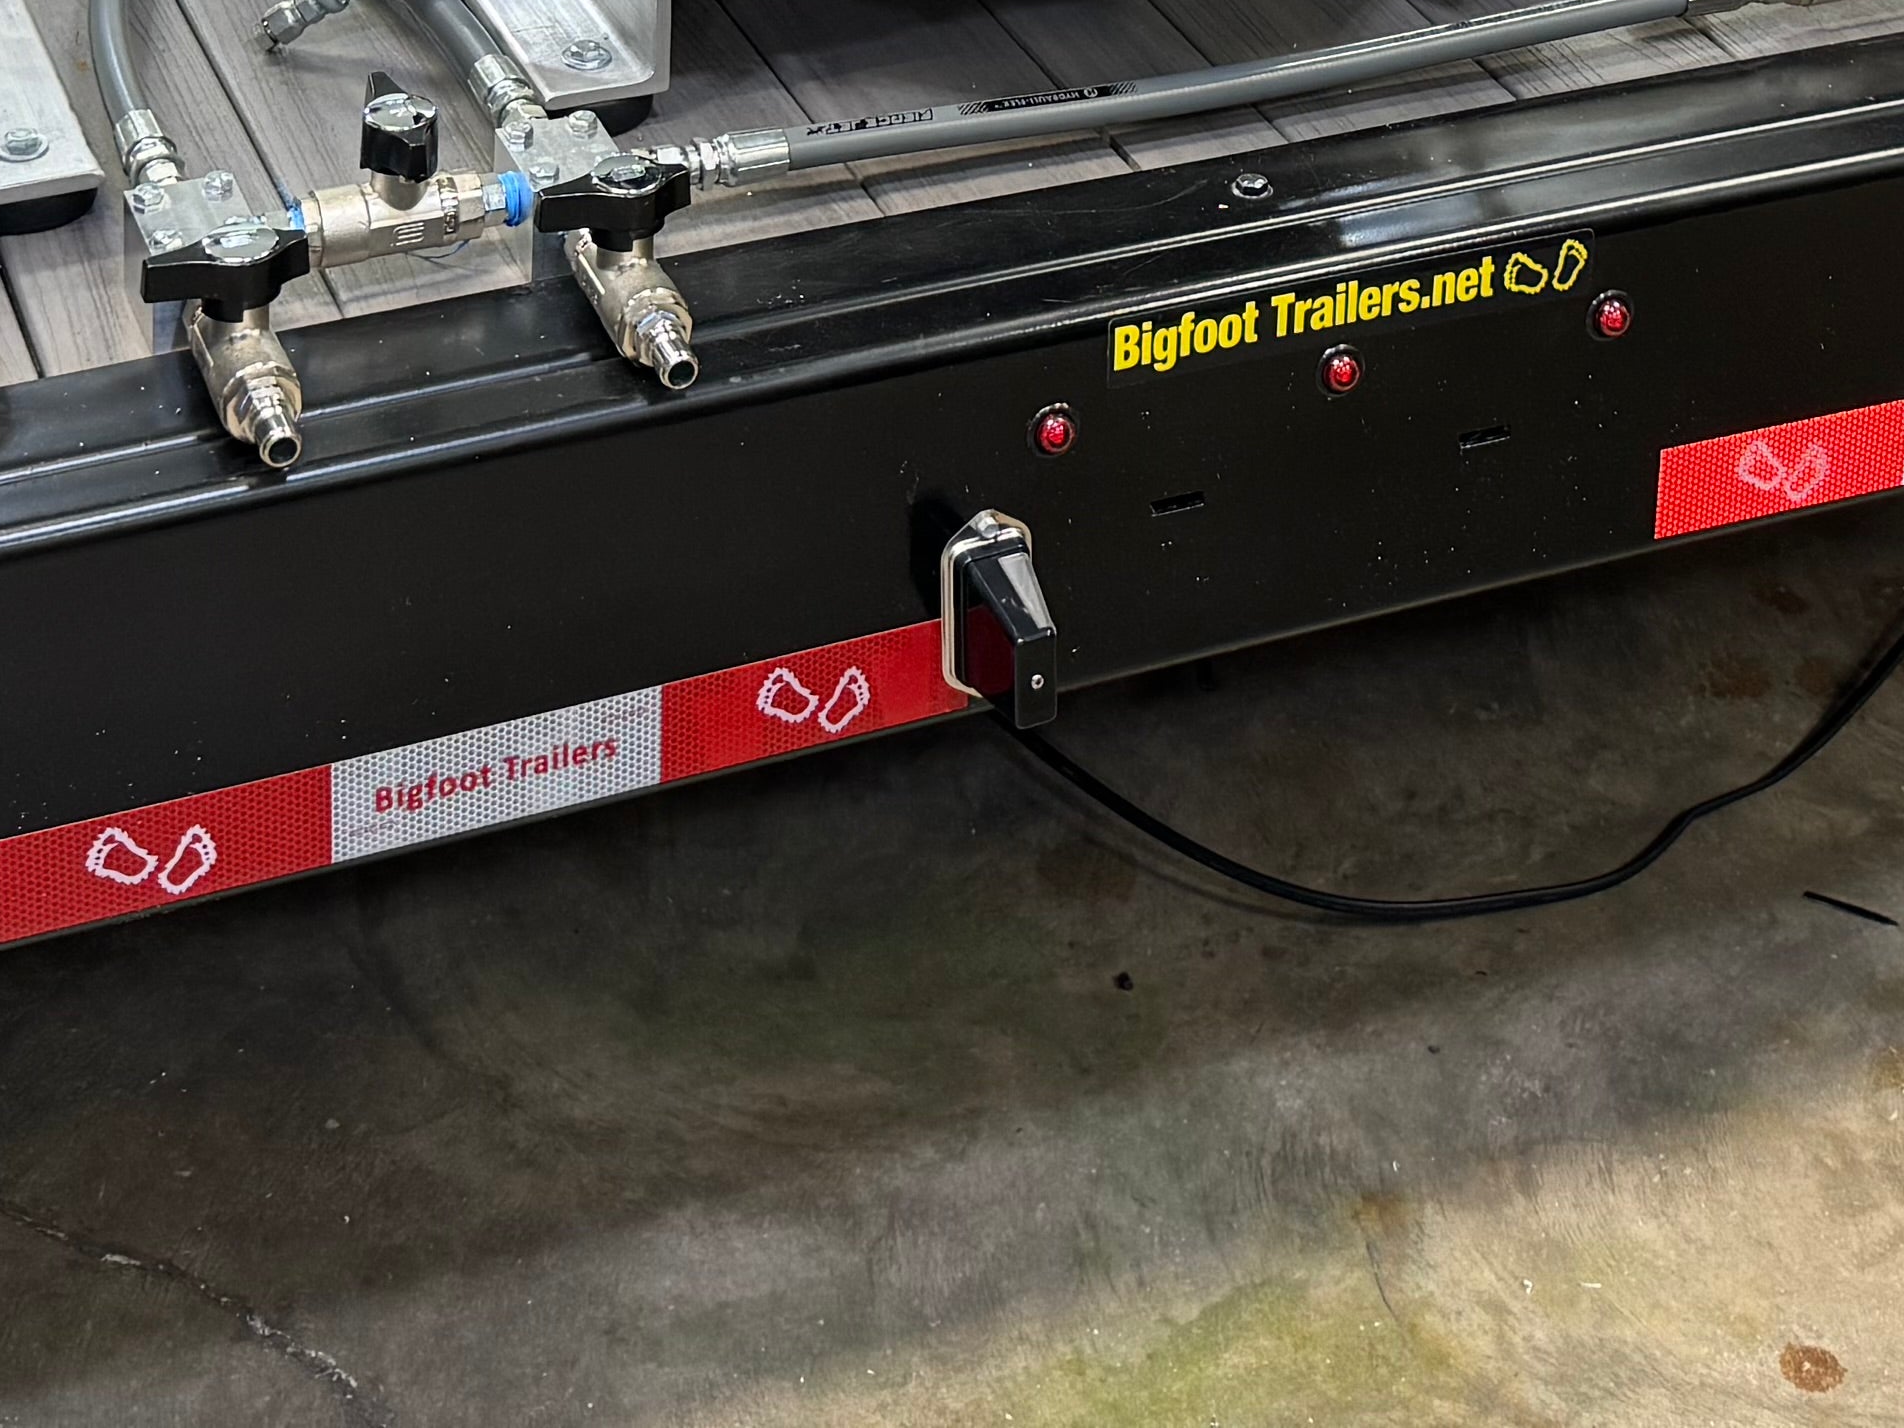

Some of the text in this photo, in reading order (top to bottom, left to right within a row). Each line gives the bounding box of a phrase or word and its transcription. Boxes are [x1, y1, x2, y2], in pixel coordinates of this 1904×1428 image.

[1113, 255, 1496, 372] Bigfoot Trailers.net
[374, 736, 620, 814] Bigfoot Trailers
